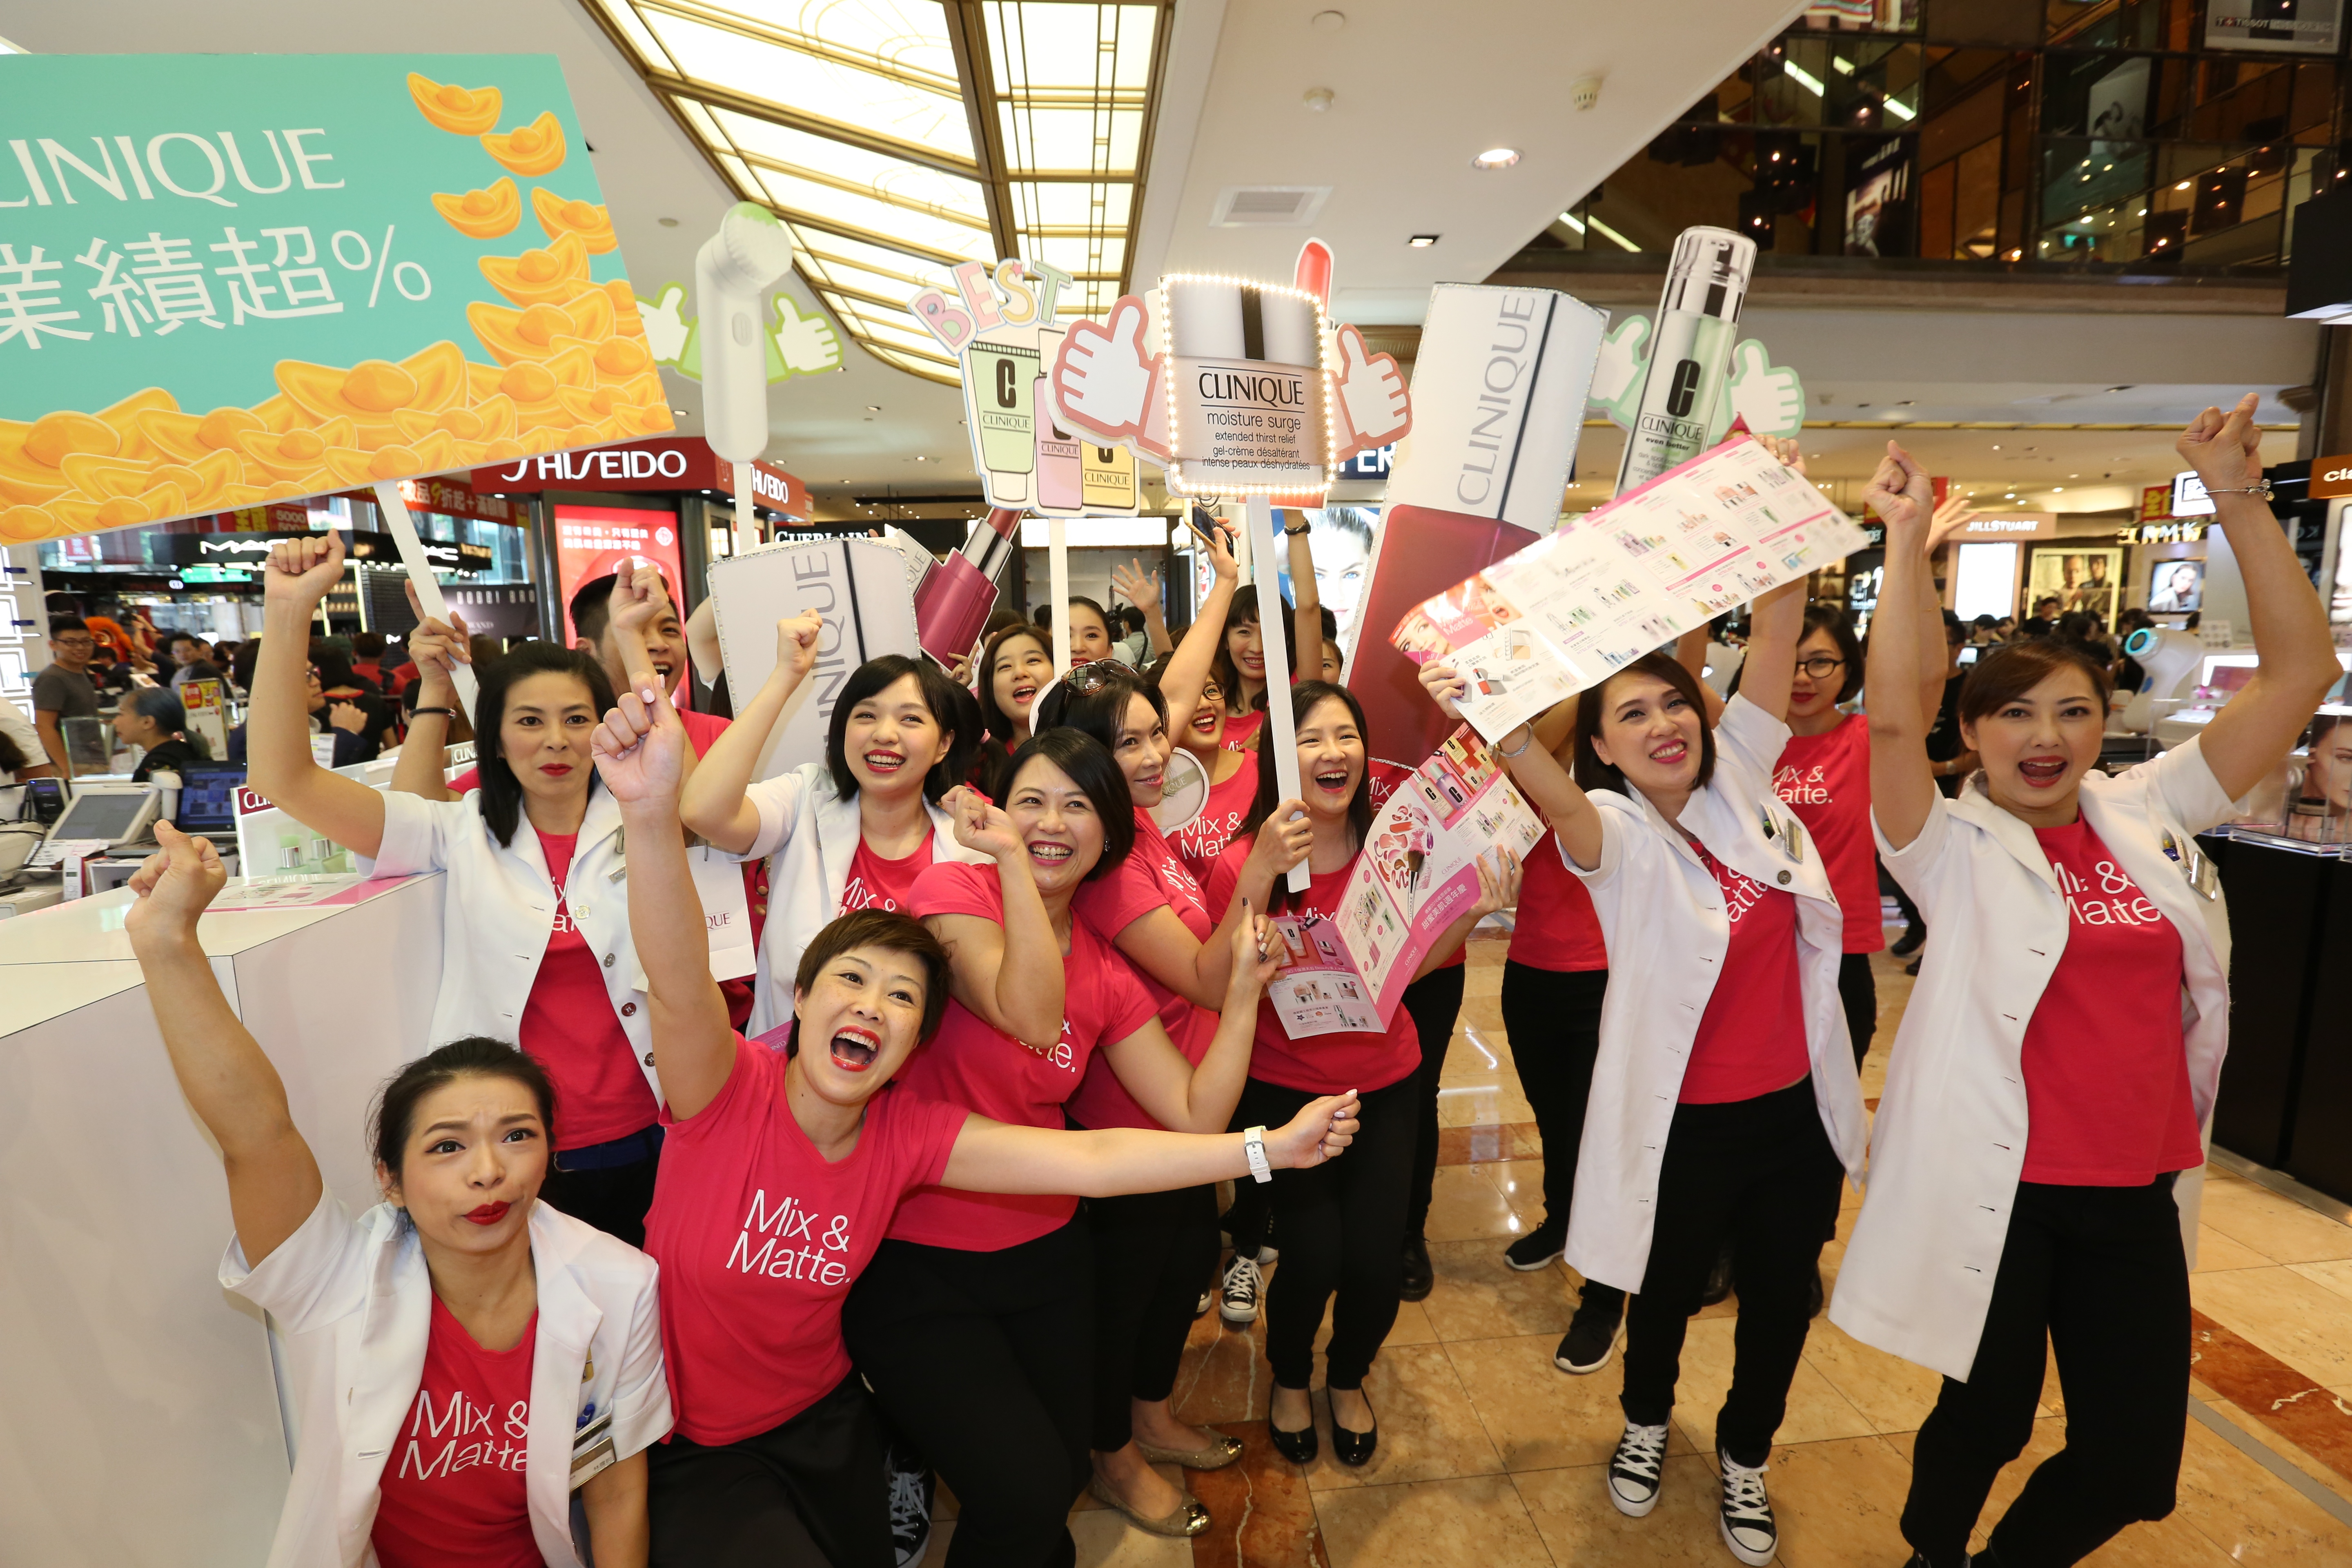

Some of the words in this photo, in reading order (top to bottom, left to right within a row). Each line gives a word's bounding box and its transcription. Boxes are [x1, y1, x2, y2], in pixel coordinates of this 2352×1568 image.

[0, 127, 345, 207] INIQUE
[0, 225, 432, 350] 業績超%
[916, 262, 1071, 347] BEST
[1199, 372, 1305, 408] CLINIQUE
[1457, 294, 1535, 506] CLINIQUE
[983, 414, 1031, 430] CLINIQUE
[1207, 411, 1263, 427] moisture
[1268, 414, 1301, 433] surge
[1642, 416, 1703, 440] CLINIQUE
[1042, 443, 1078, 455] CLINIQUE
[1215, 432, 1254, 442] extended
[1256, 433, 1276, 443] thirst
[1278, 434, 1296, 444] relief
[1646, 437, 1664, 445] even
[1666, 439, 1690, 451] better
[1213, 445, 1254, 457] gel-crème
[1257, 447, 1300, 458] désaltérant
[501, 450, 687, 482] SHISEIDO
[1202, 457, 1230, 468] intense
[1232, 460, 1258, 470] peaux
[1261, 458, 1310, 471] déshydratées
[750, 463, 788, 504] HISEIDO
[1085, 472, 1130, 486] CLINIQUE
[2142, 521, 2198, 539] RMK
[1443, 617, 1473, 635] Matte
[1806, 765, 1825, 782] &
[243, 791, 271, 809] CLI
[1226, 812, 1241, 831] &
[1441, 857, 1463, 875] CLINIQUE
[2095, 860, 2136, 894] &
[1421, 883, 1468, 931] 甜蜜美肌週年慶
[1727, 878, 1768, 923] atte
[1405, 946, 1418, 966] CLINIQUE
[744, 1189, 819, 1241] Mix
[822, 1214, 850, 1253] &
[726, 1230, 851, 1286] Matte.
[410, 1390, 495, 1439] Mix
[503, 1400, 528, 1440] &
